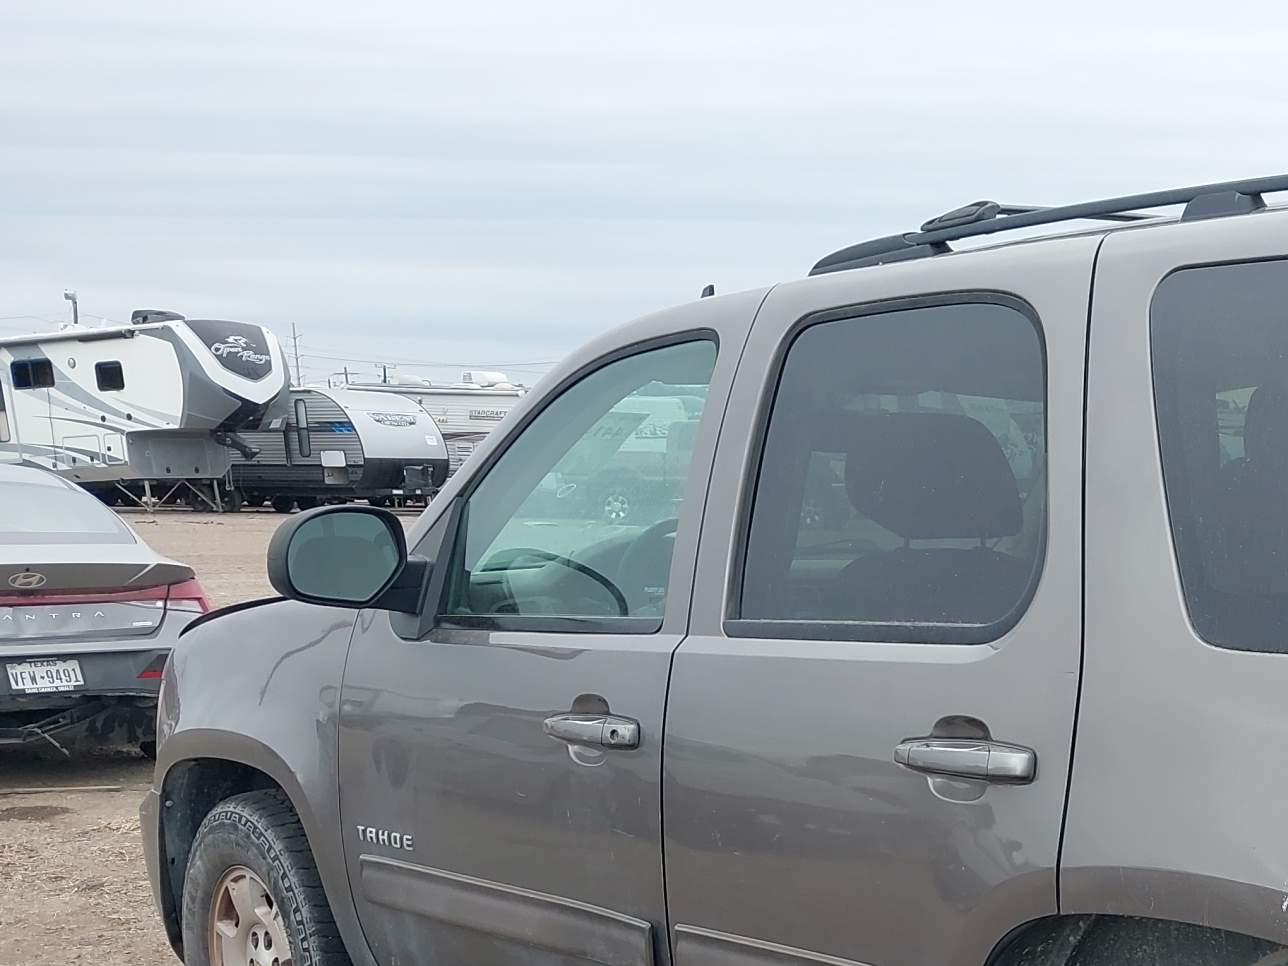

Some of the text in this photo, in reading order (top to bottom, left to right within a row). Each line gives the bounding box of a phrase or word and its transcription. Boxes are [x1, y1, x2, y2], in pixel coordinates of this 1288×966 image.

[211, 342, 243, 358] Open
[237, 350, 271, 364] Range
[356, 825, 414, 851] TAHOE
